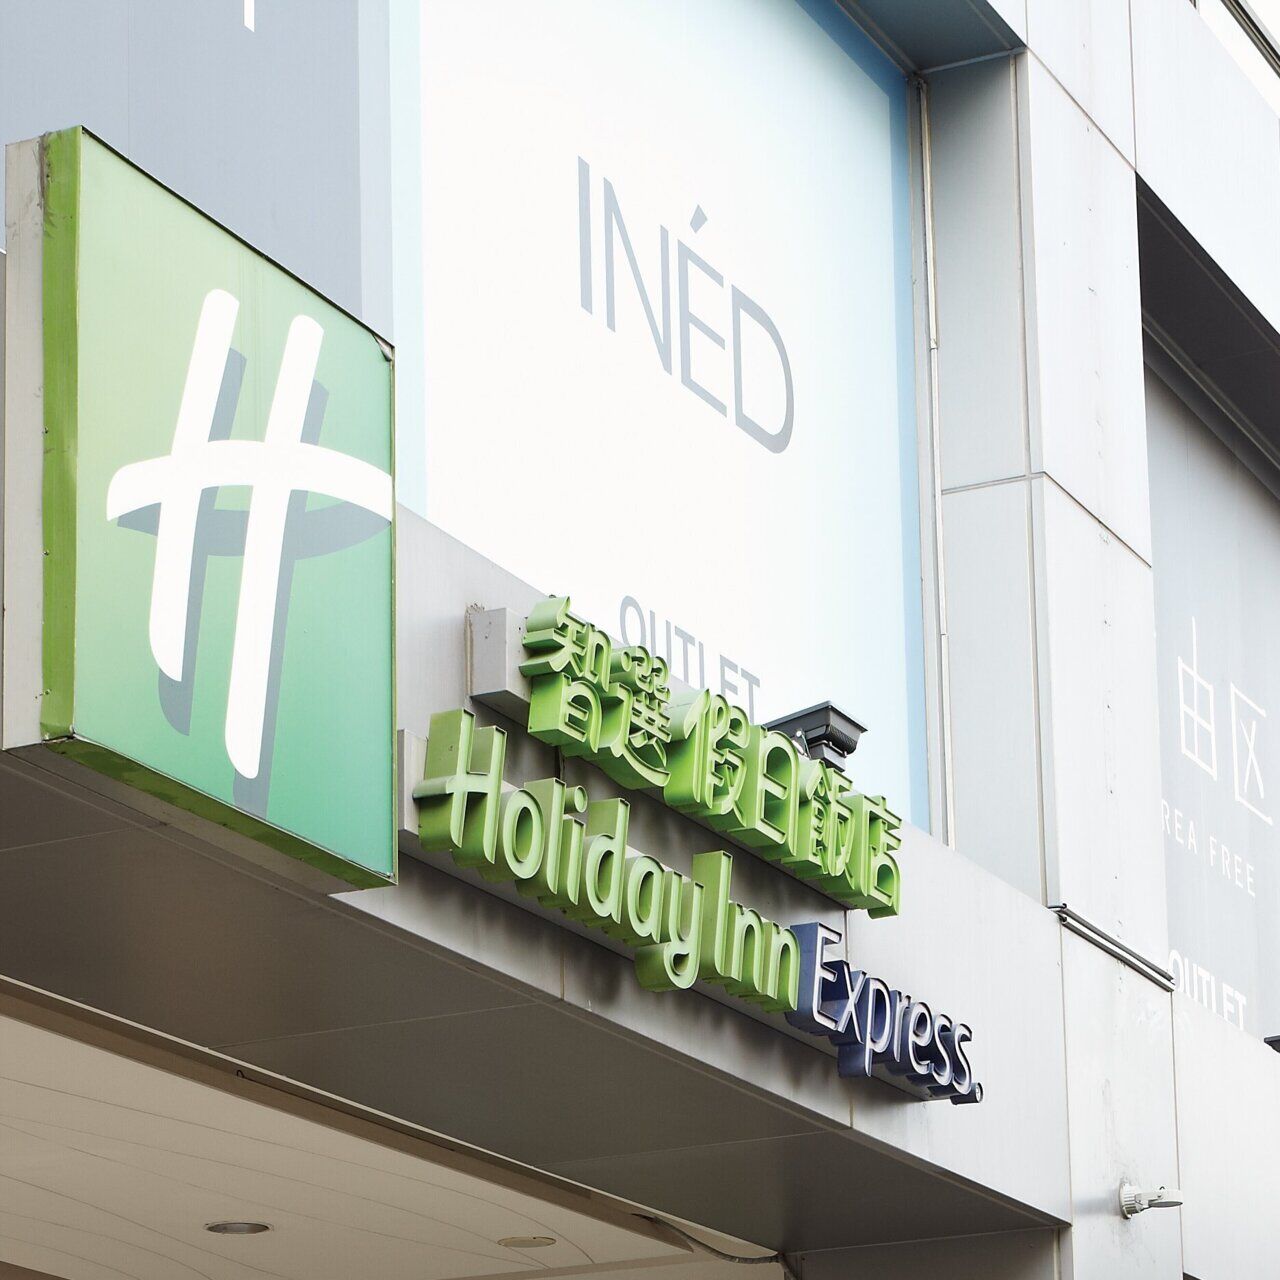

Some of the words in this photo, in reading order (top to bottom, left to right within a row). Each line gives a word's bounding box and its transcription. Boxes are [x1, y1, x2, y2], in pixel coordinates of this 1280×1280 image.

[578, 155, 795, 456] INÉD
[413, 708, 704, 990] Holiday
[694, 851, 800, 1012] Inn
[790, 922, 976, 1096] Express
[1209, 835, 1257, 899] FREE
